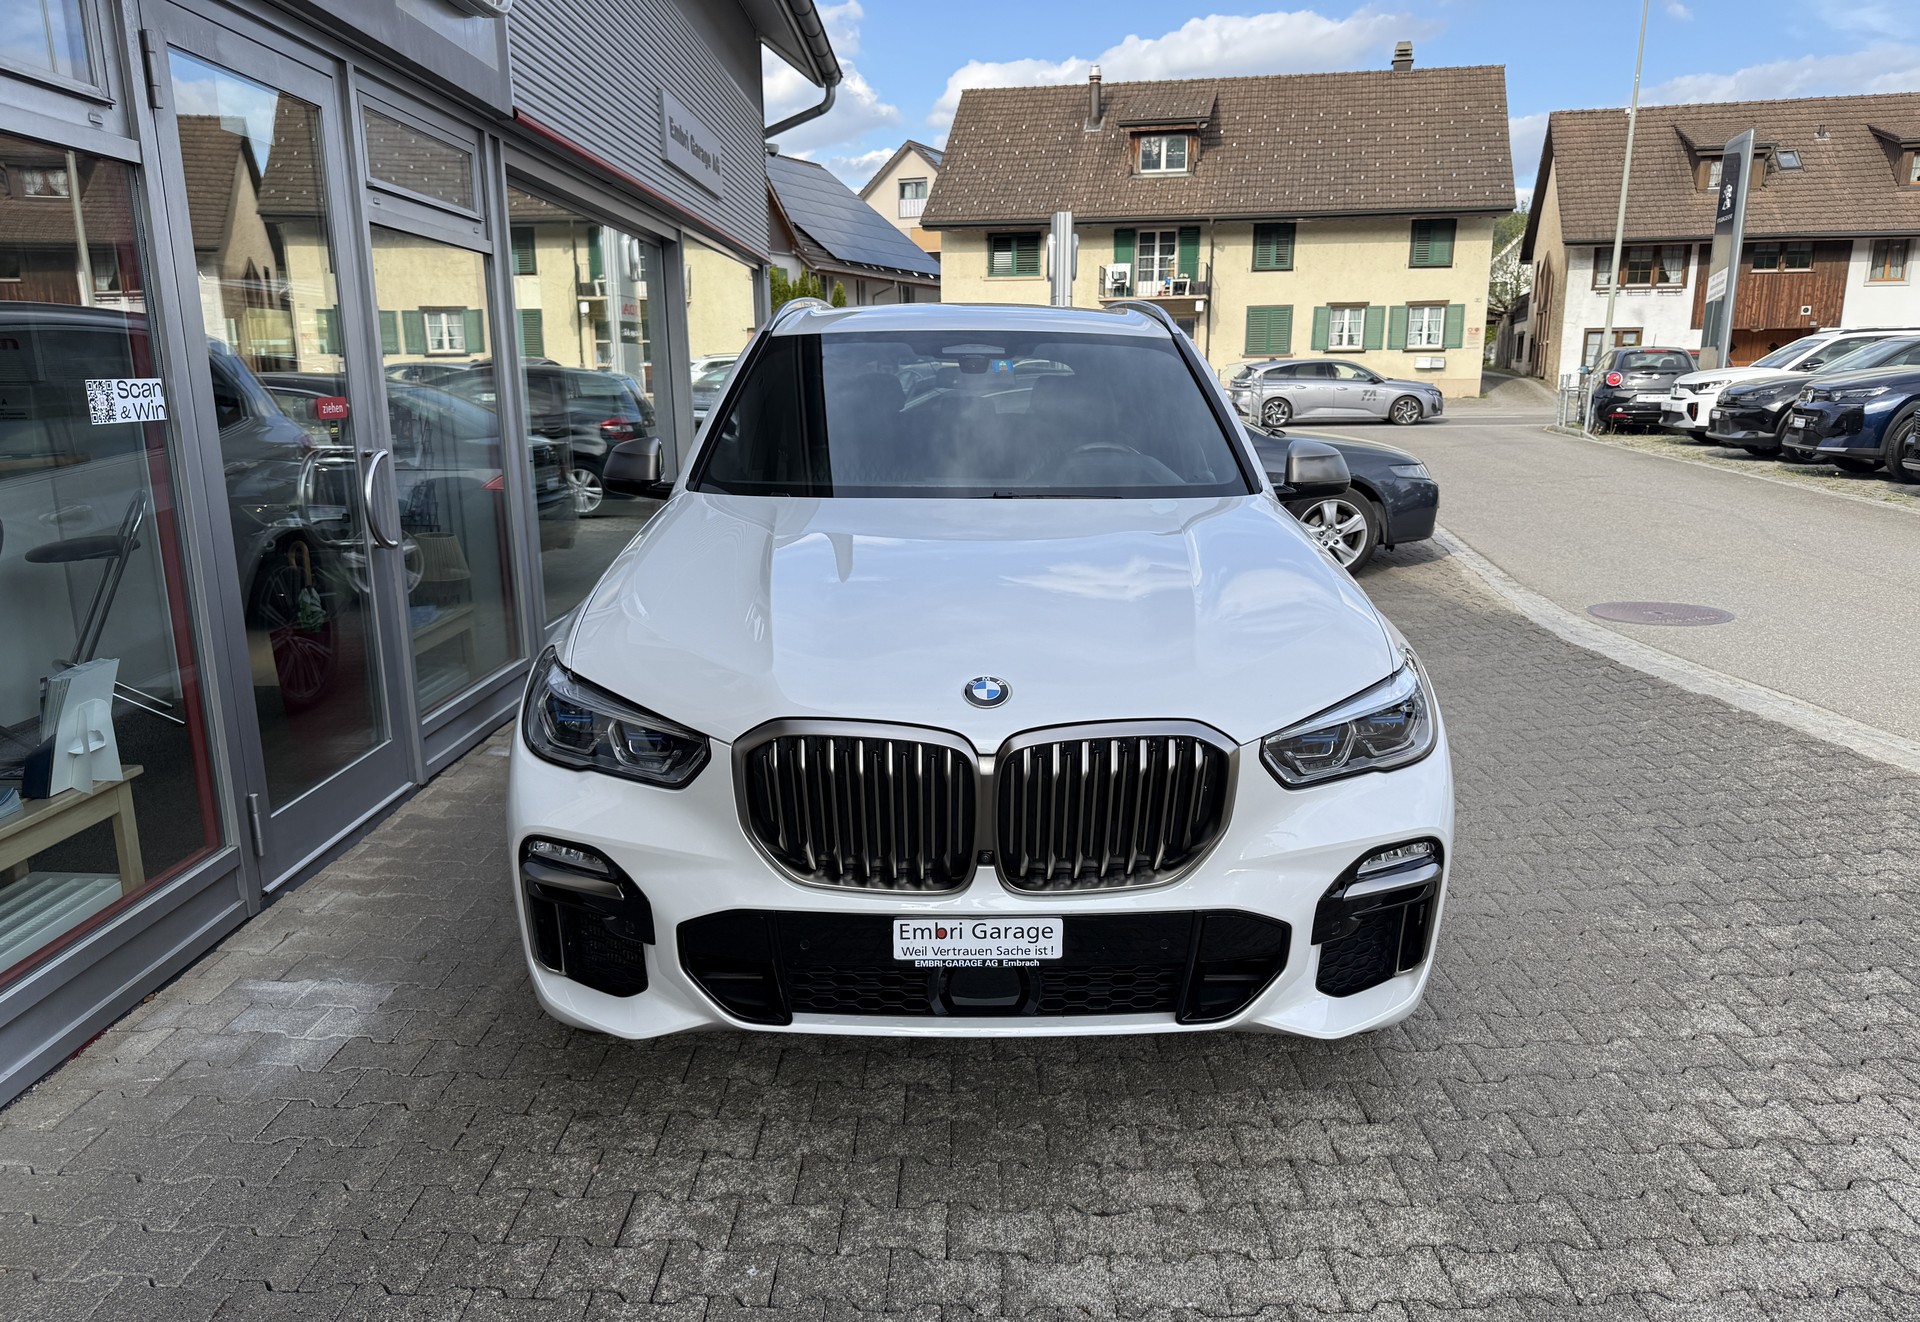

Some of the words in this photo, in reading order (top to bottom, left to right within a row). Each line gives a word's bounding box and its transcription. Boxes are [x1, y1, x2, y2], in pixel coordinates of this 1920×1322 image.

[668, 115, 689, 151] Embri
[690, 134, 711, 170] Garage
[117, 380, 163, 399] Scan
[121, 406, 131, 419] &
[133, 400, 167, 420] Win
[322, 402, 344, 414] ziehen
[969, 676, 1005, 686] BMW
[899, 922, 963, 940] Embri
[972, 923, 1054, 943] Garage
[901, 946, 928, 956] Weil
[932, 946, 992, 956] Vertrauen
[996, 946, 1031, 956] Sache
[1003, 959, 1039, 967] Embrach
